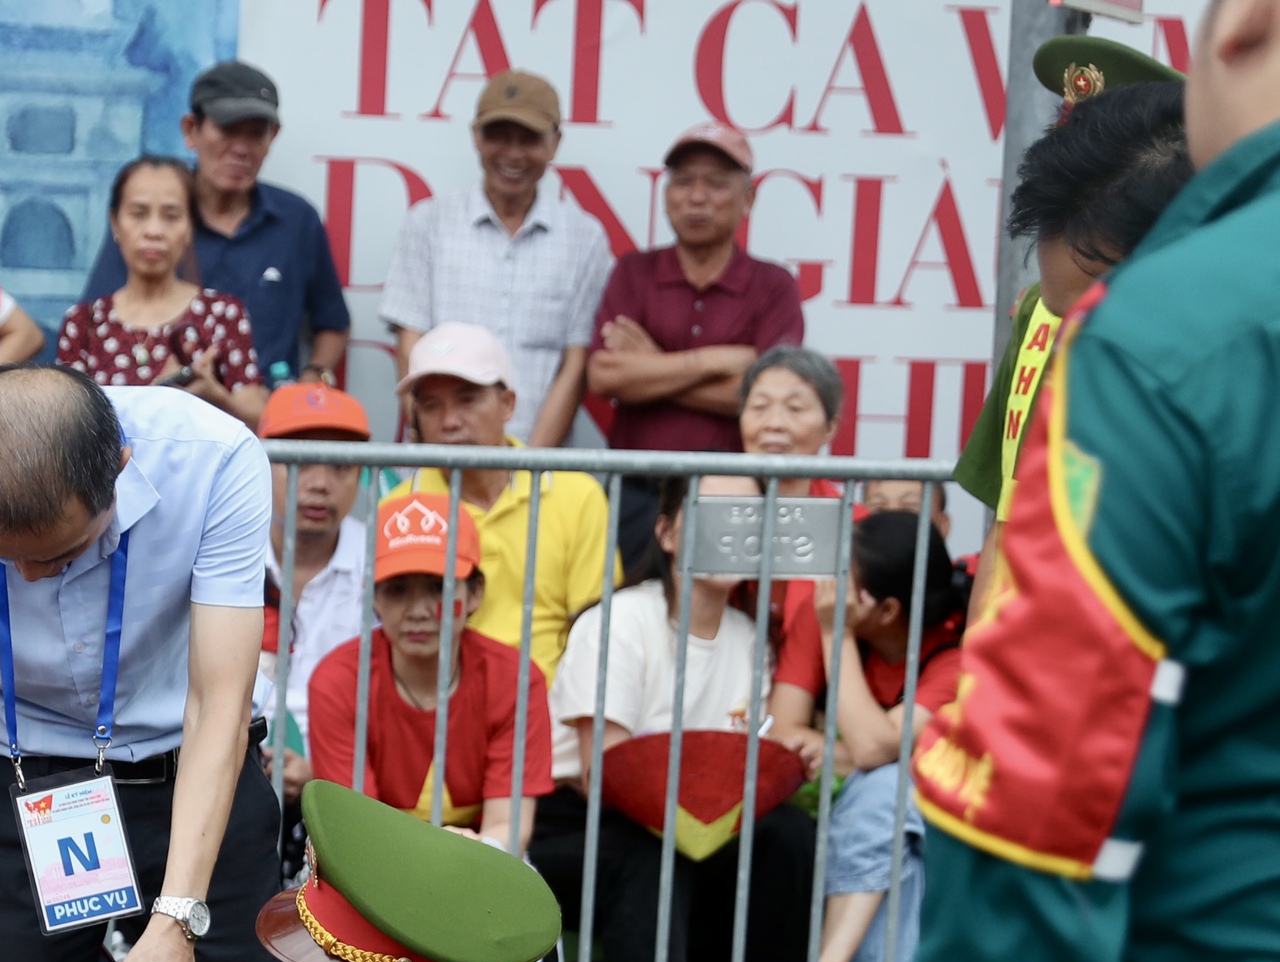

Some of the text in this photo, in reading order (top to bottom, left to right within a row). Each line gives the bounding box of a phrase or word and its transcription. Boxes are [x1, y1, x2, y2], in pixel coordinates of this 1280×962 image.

[734, 157, 1003, 312] GIÀ
[56, 831, 101, 877] N
[53, 890, 128, 920] PHỤC VỤ
